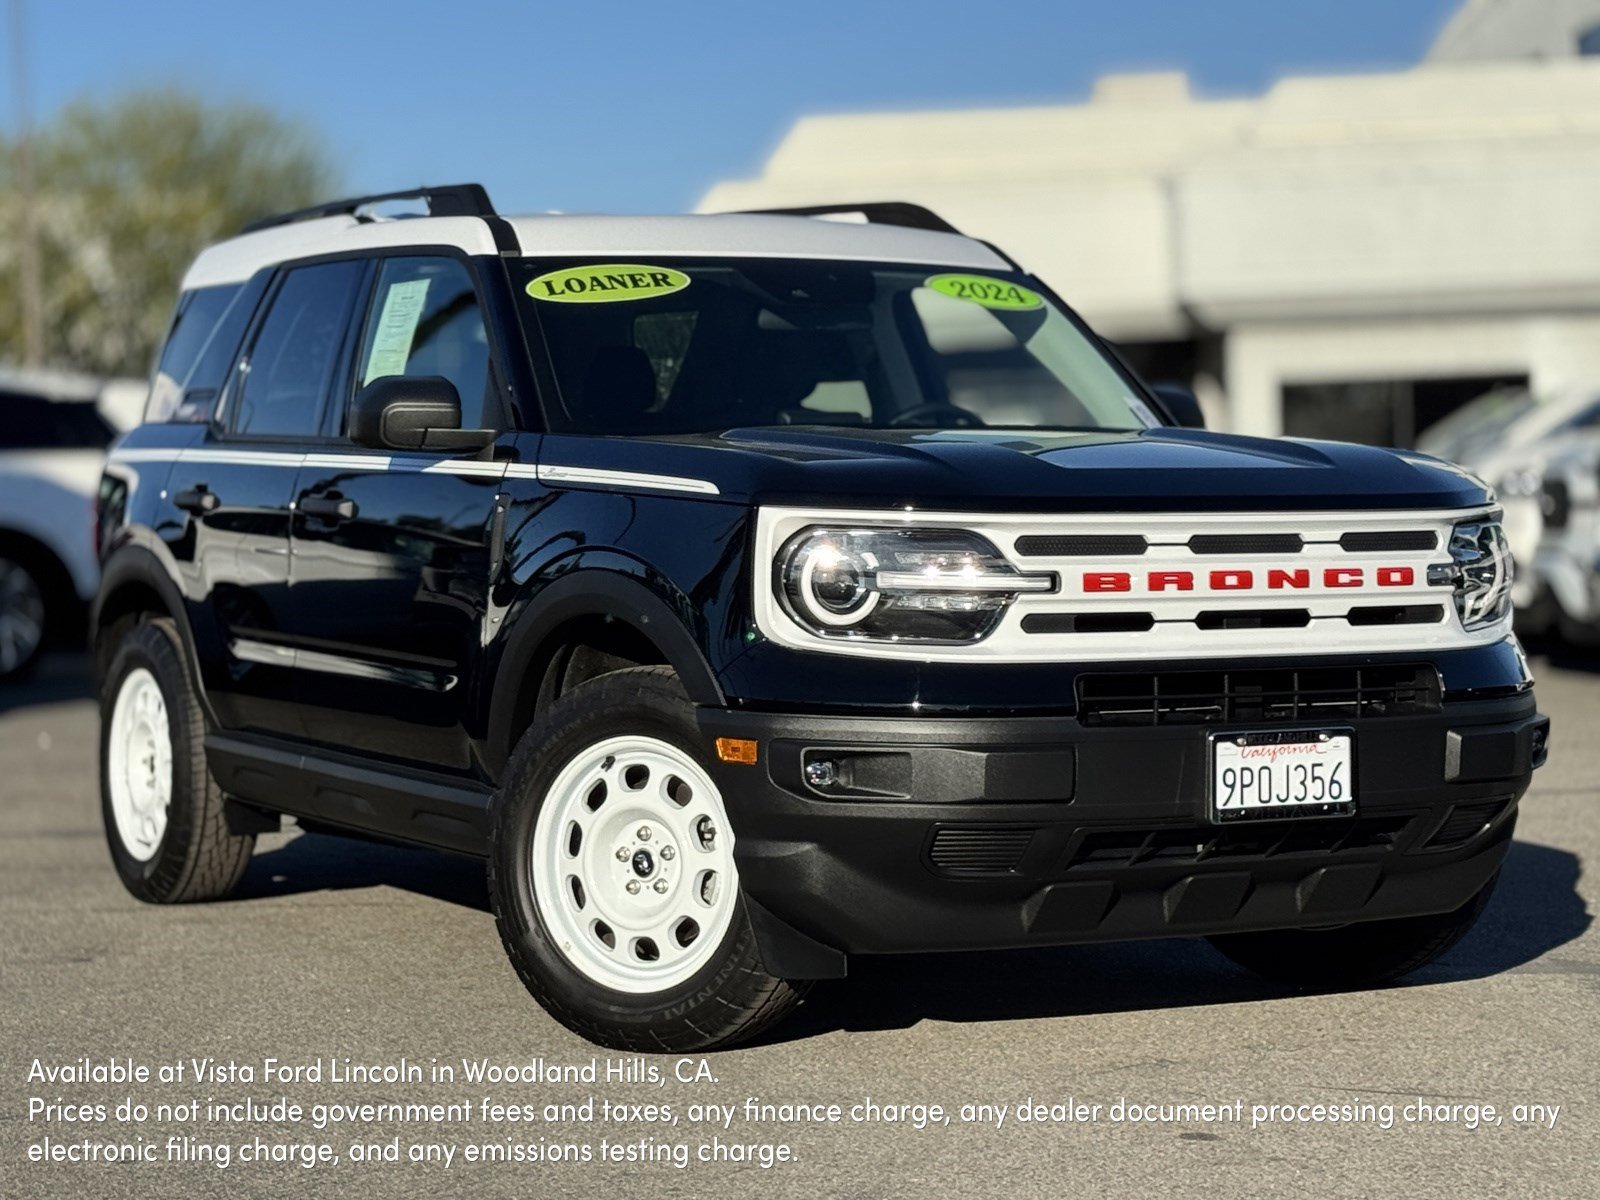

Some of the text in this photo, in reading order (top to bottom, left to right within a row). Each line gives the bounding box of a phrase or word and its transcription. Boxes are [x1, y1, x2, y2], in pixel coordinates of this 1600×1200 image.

[542, 272, 675, 296] LOANER
[949, 281, 1025, 303] 2024
[1083, 566, 1414, 592] BRONCO
[1240, 743, 1327, 764] California
